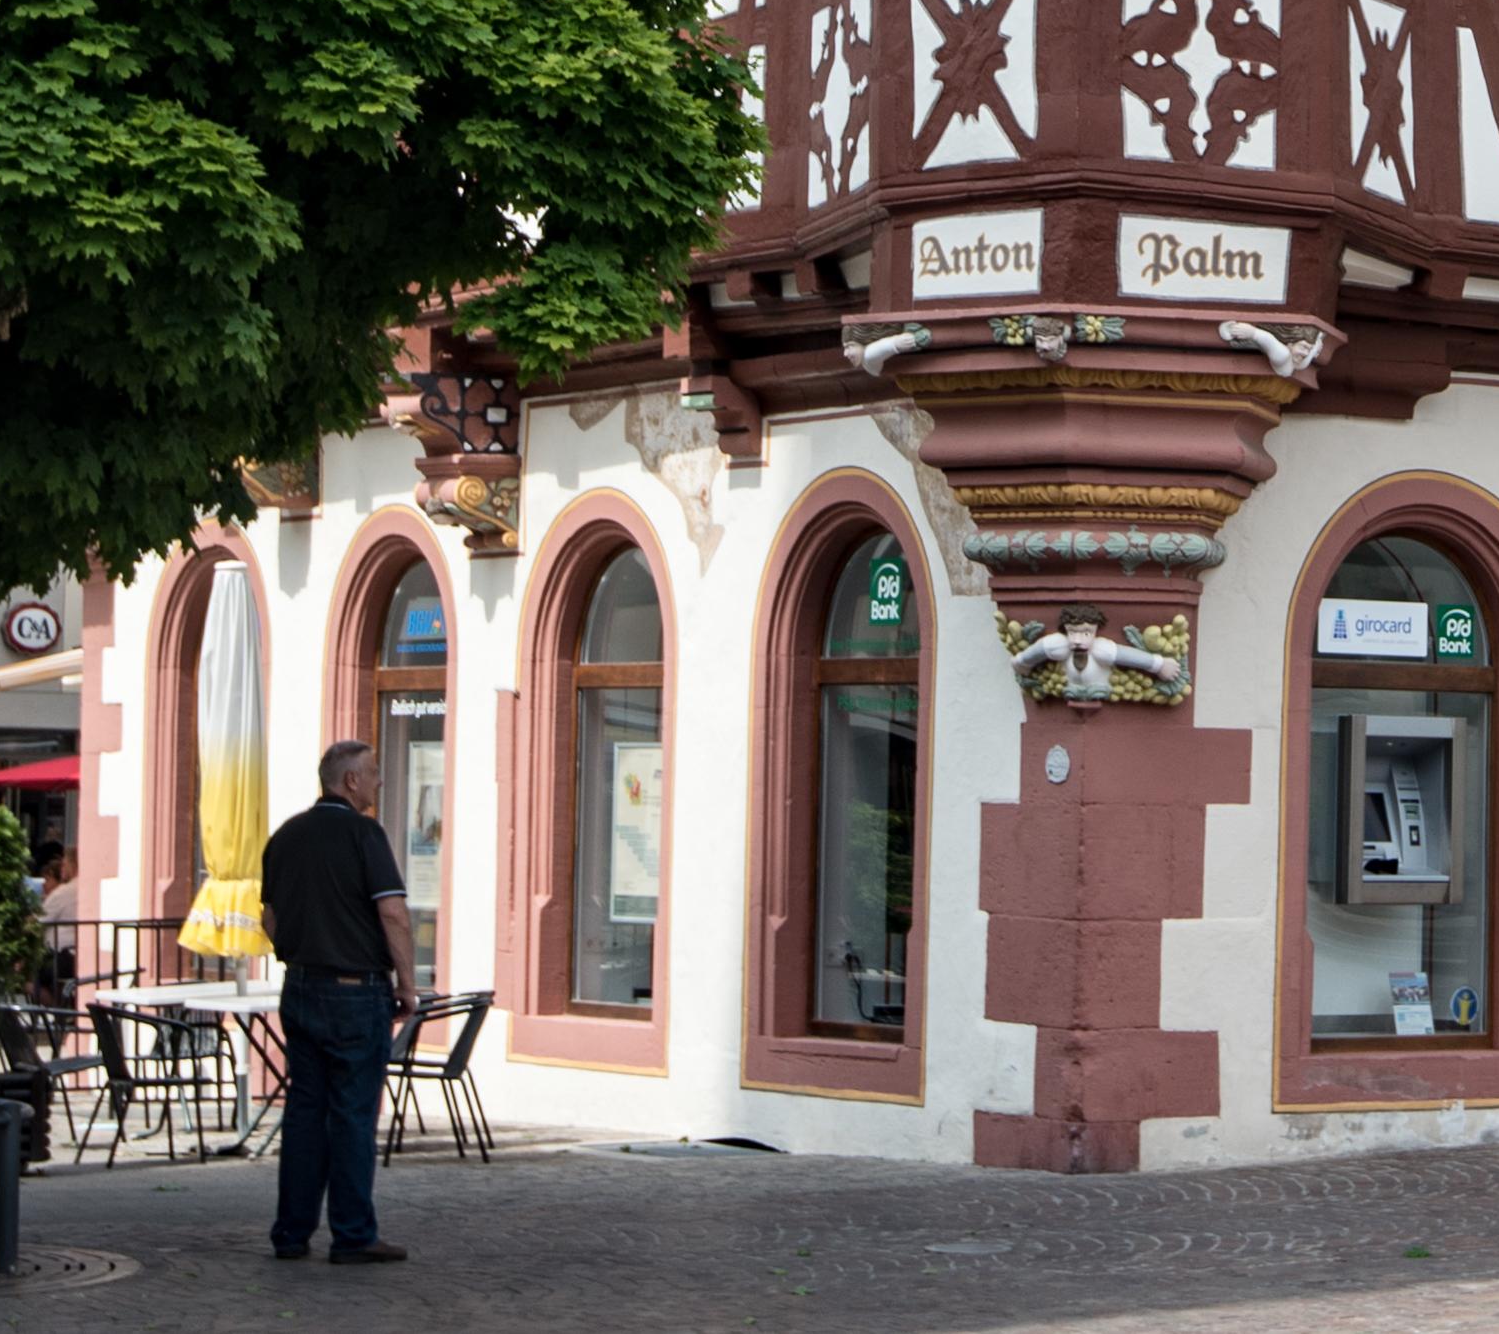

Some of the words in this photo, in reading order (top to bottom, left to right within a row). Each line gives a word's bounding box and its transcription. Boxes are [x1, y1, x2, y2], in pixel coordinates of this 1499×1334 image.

[918, 232, 1036, 279] Anton
[1137, 232, 1266, 287] Palm
[870, 600, 900, 620] Bank
[16, 616, 54, 641] C&A
[1355, 614, 1412, 637] girocard
[1438, 637, 1472, 654] Bank
